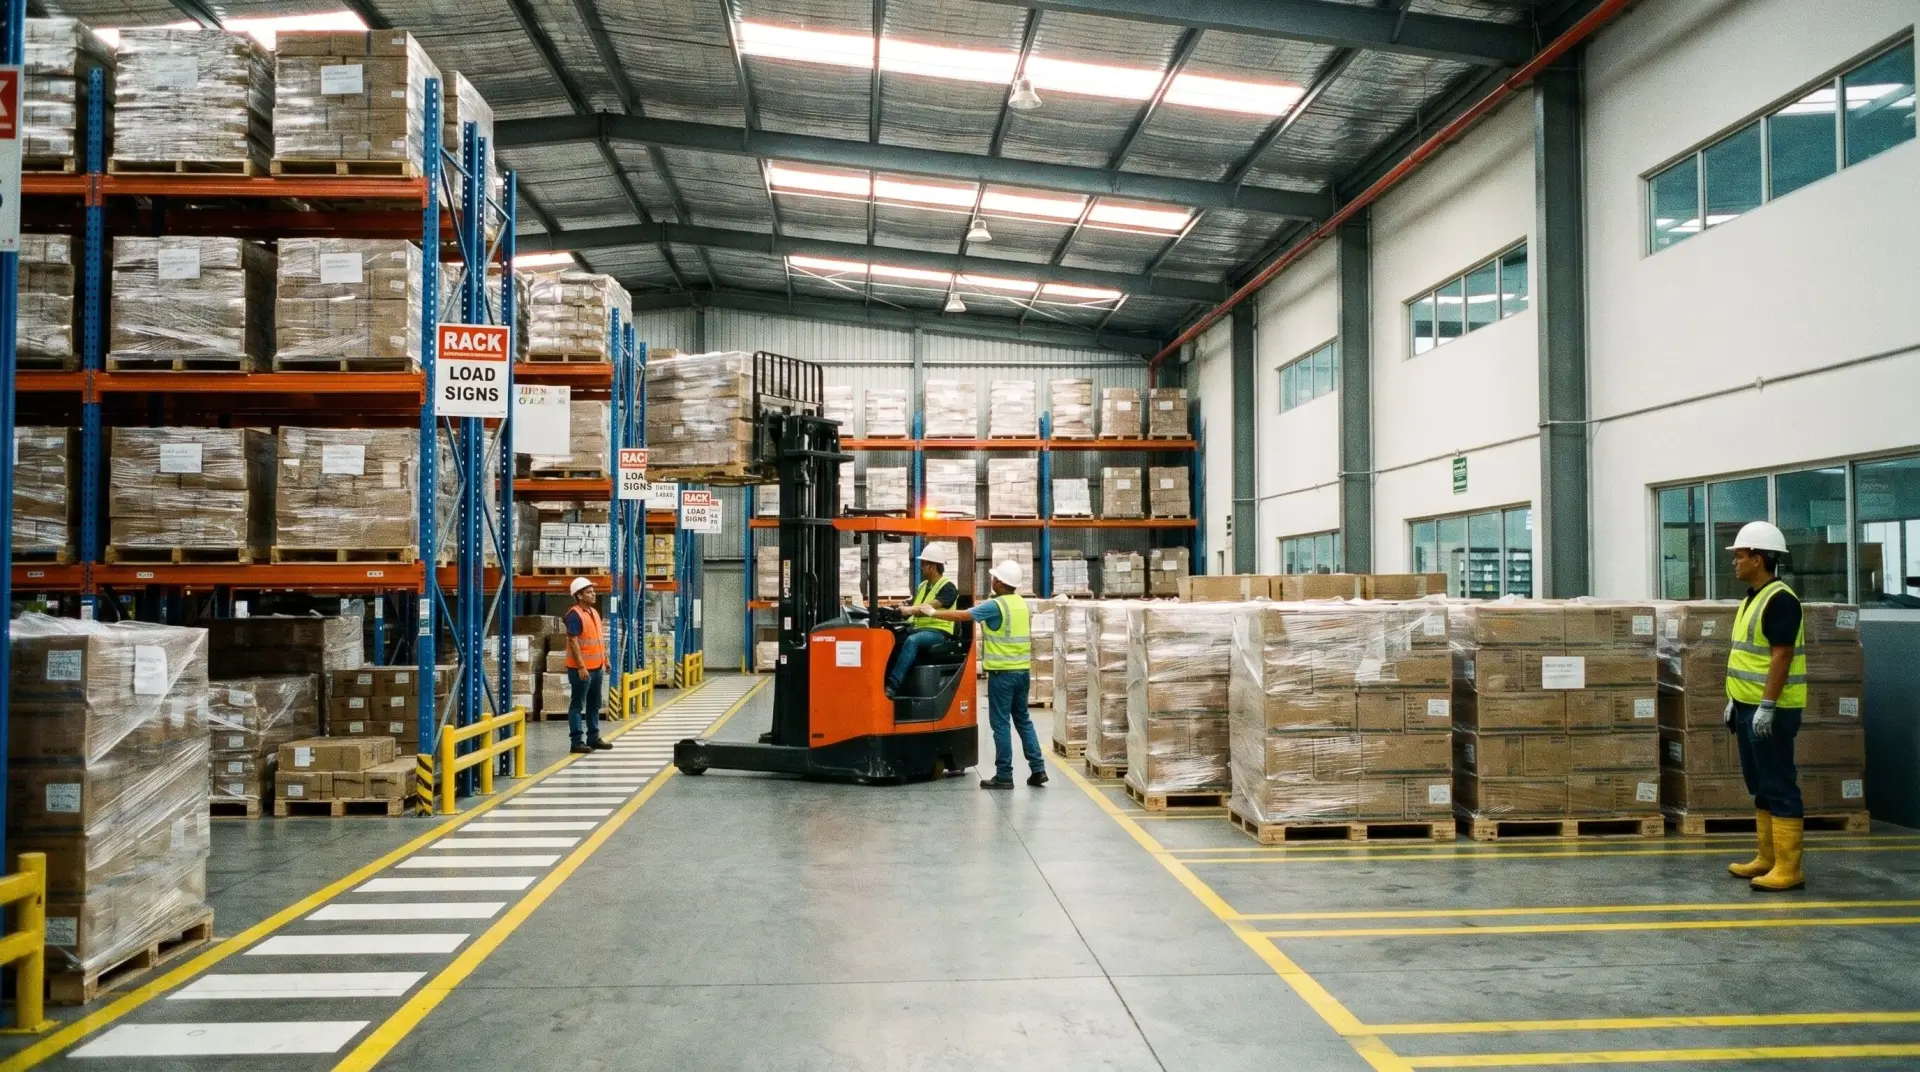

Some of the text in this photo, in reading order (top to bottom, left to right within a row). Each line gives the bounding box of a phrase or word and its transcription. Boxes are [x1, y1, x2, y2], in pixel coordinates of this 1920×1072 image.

[444, 331, 502, 352] RACK
[449, 366, 496, 381] LOAD
[445, 386, 499, 401] SIGNS
[621, 452, 648, 463] RAC
[625, 472, 644, 480] LOA
[623, 482, 652, 490] SIGNS
[684, 493, 709, 503] RACK
